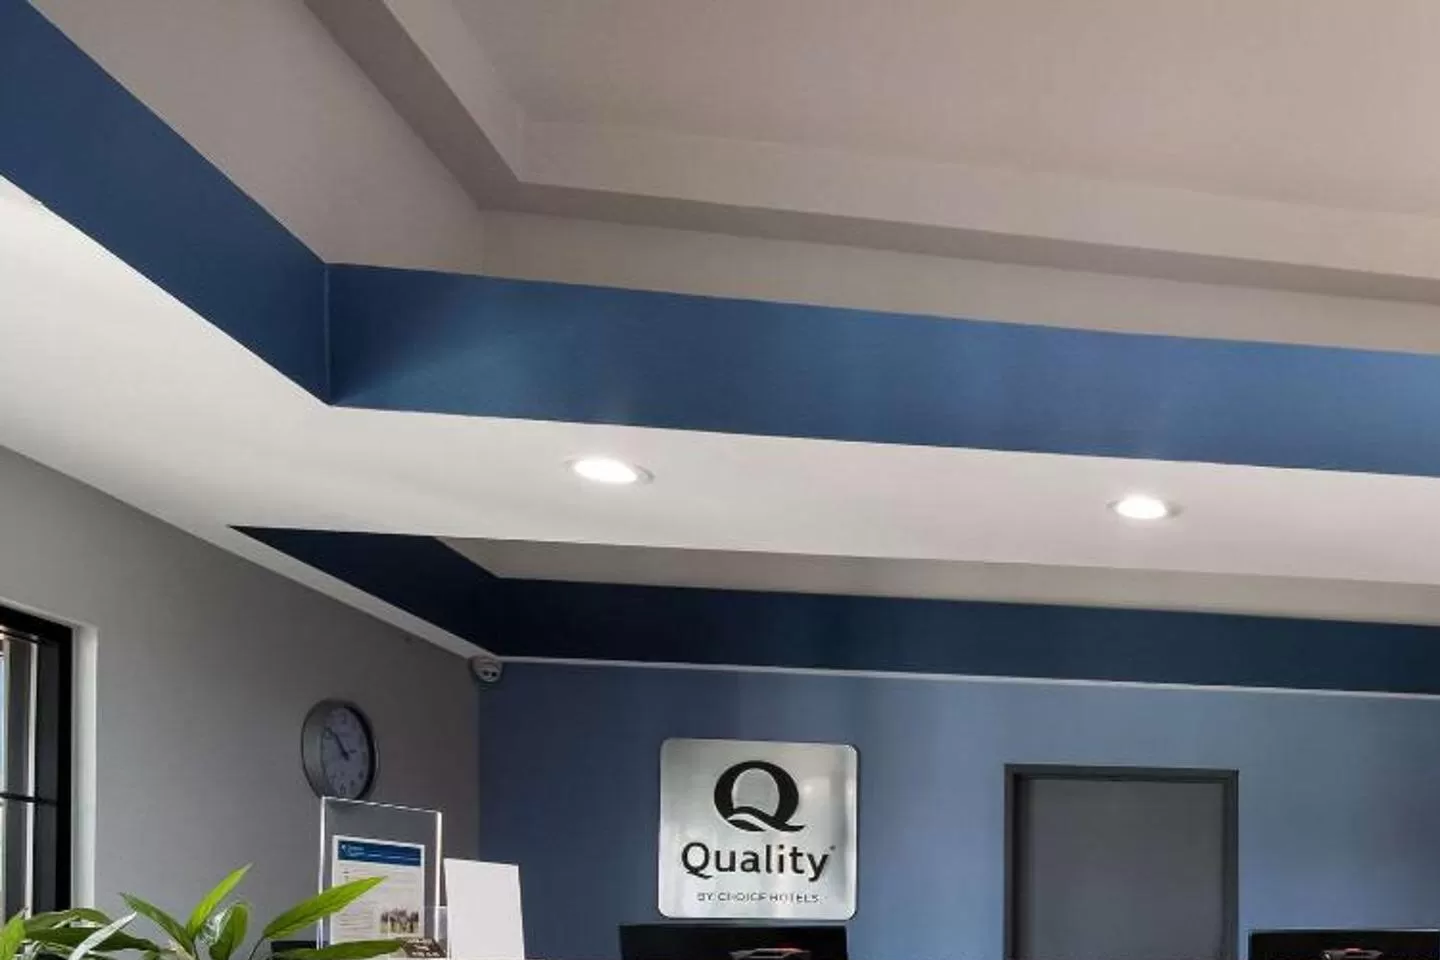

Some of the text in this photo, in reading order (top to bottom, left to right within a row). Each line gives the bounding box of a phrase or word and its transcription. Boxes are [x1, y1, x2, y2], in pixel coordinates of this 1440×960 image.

[713, 760, 805, 832] Q
[681, 842, 830, 882] Quality
[696, 892, 820, 904] BY CHOICE HOTELS
